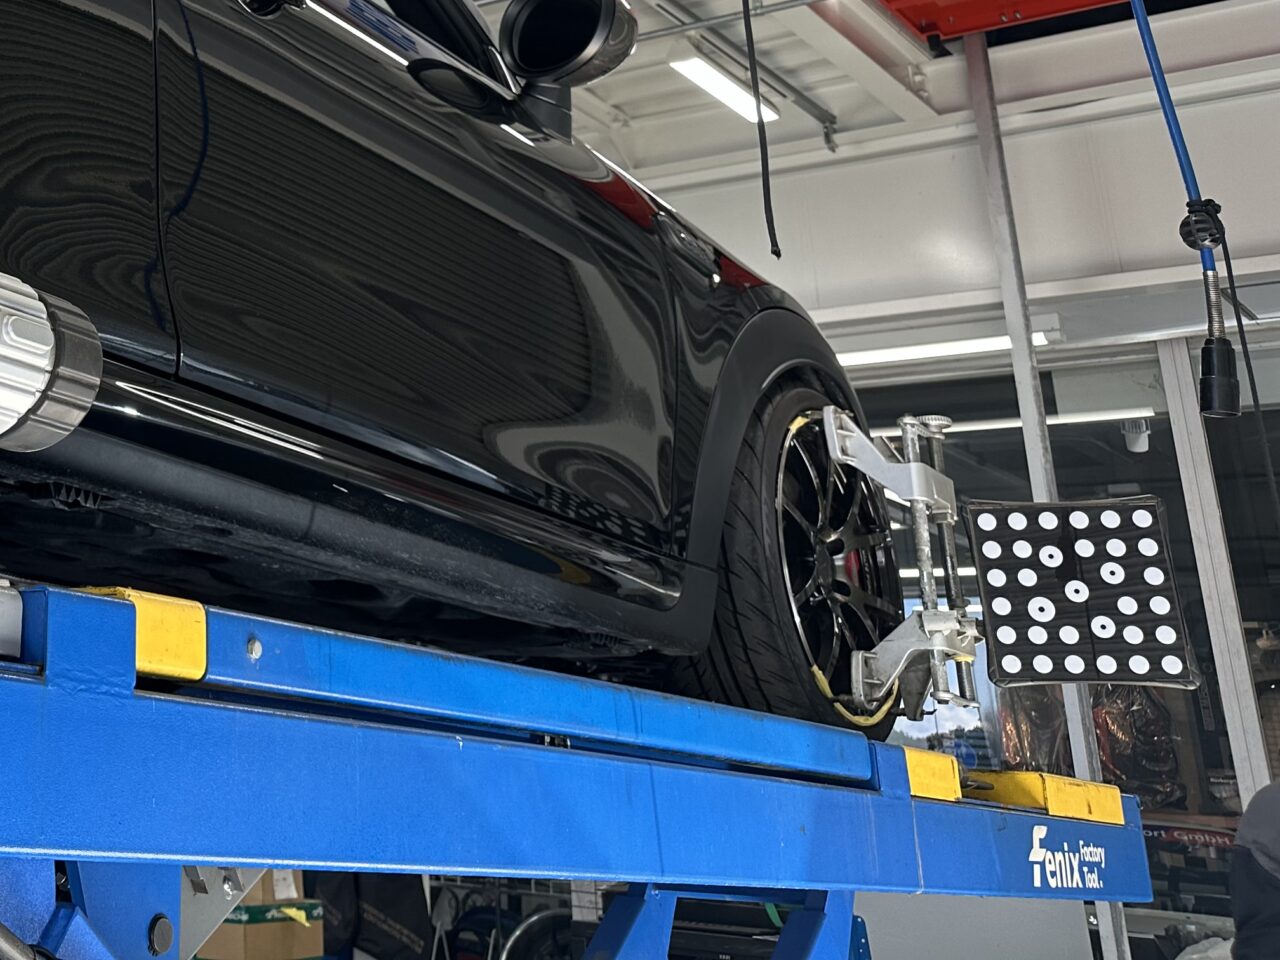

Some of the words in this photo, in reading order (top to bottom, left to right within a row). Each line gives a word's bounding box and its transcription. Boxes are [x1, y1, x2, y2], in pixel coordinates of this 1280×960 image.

[1029, 825, 1083, 888] Fenix
[1079, 840, 1105, 868] Factory
[1174, 831, 1232, 845] GmbH
